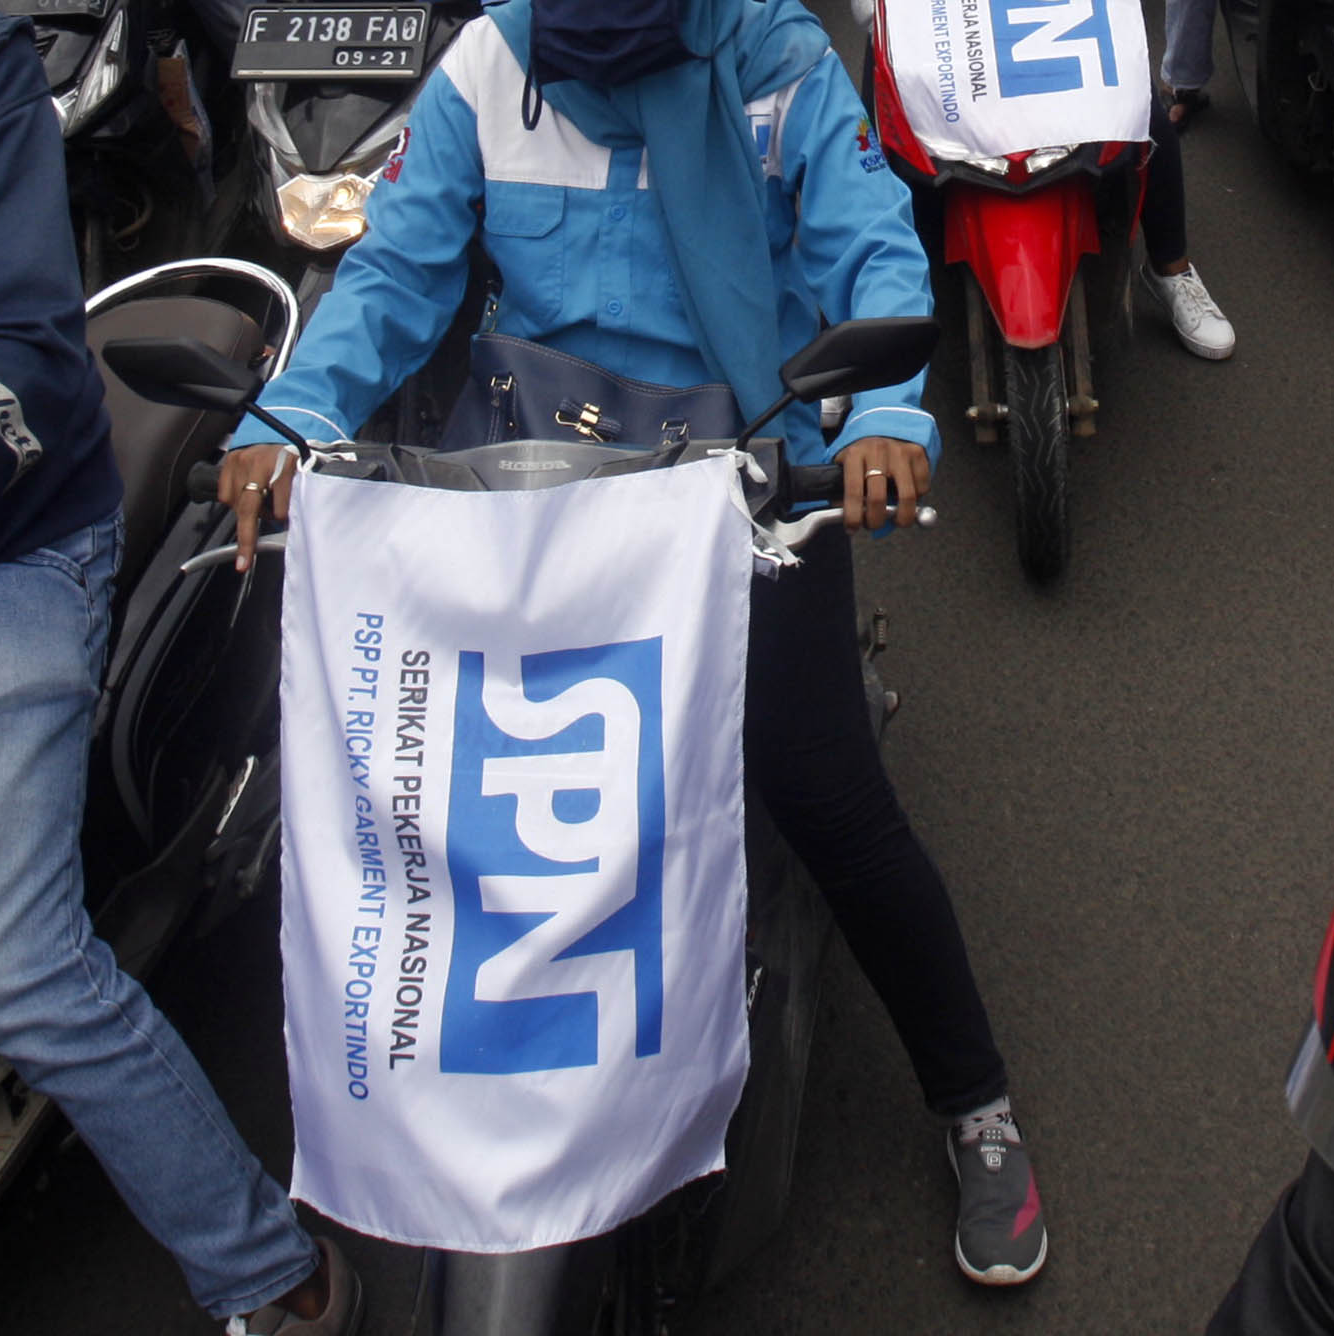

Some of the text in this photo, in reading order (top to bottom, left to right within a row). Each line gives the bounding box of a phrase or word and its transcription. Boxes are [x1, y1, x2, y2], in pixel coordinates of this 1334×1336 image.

[251, 16, 269, 42] F
[286, 16, 352, 42] 2138
[964, 27, 987, 102] NASIONAL
[934, 40, 960, 123] EXPORTINDO
[498, 459, 572, 472] HONDA
[344, 610, 388, 1103] PSP PT. RICKY GARMENT EXPORTINDO
[388, 649, 432, 1070] SERIKAT PEKERJA NASIONAL
[438, 635, 663, 1076] SPN
